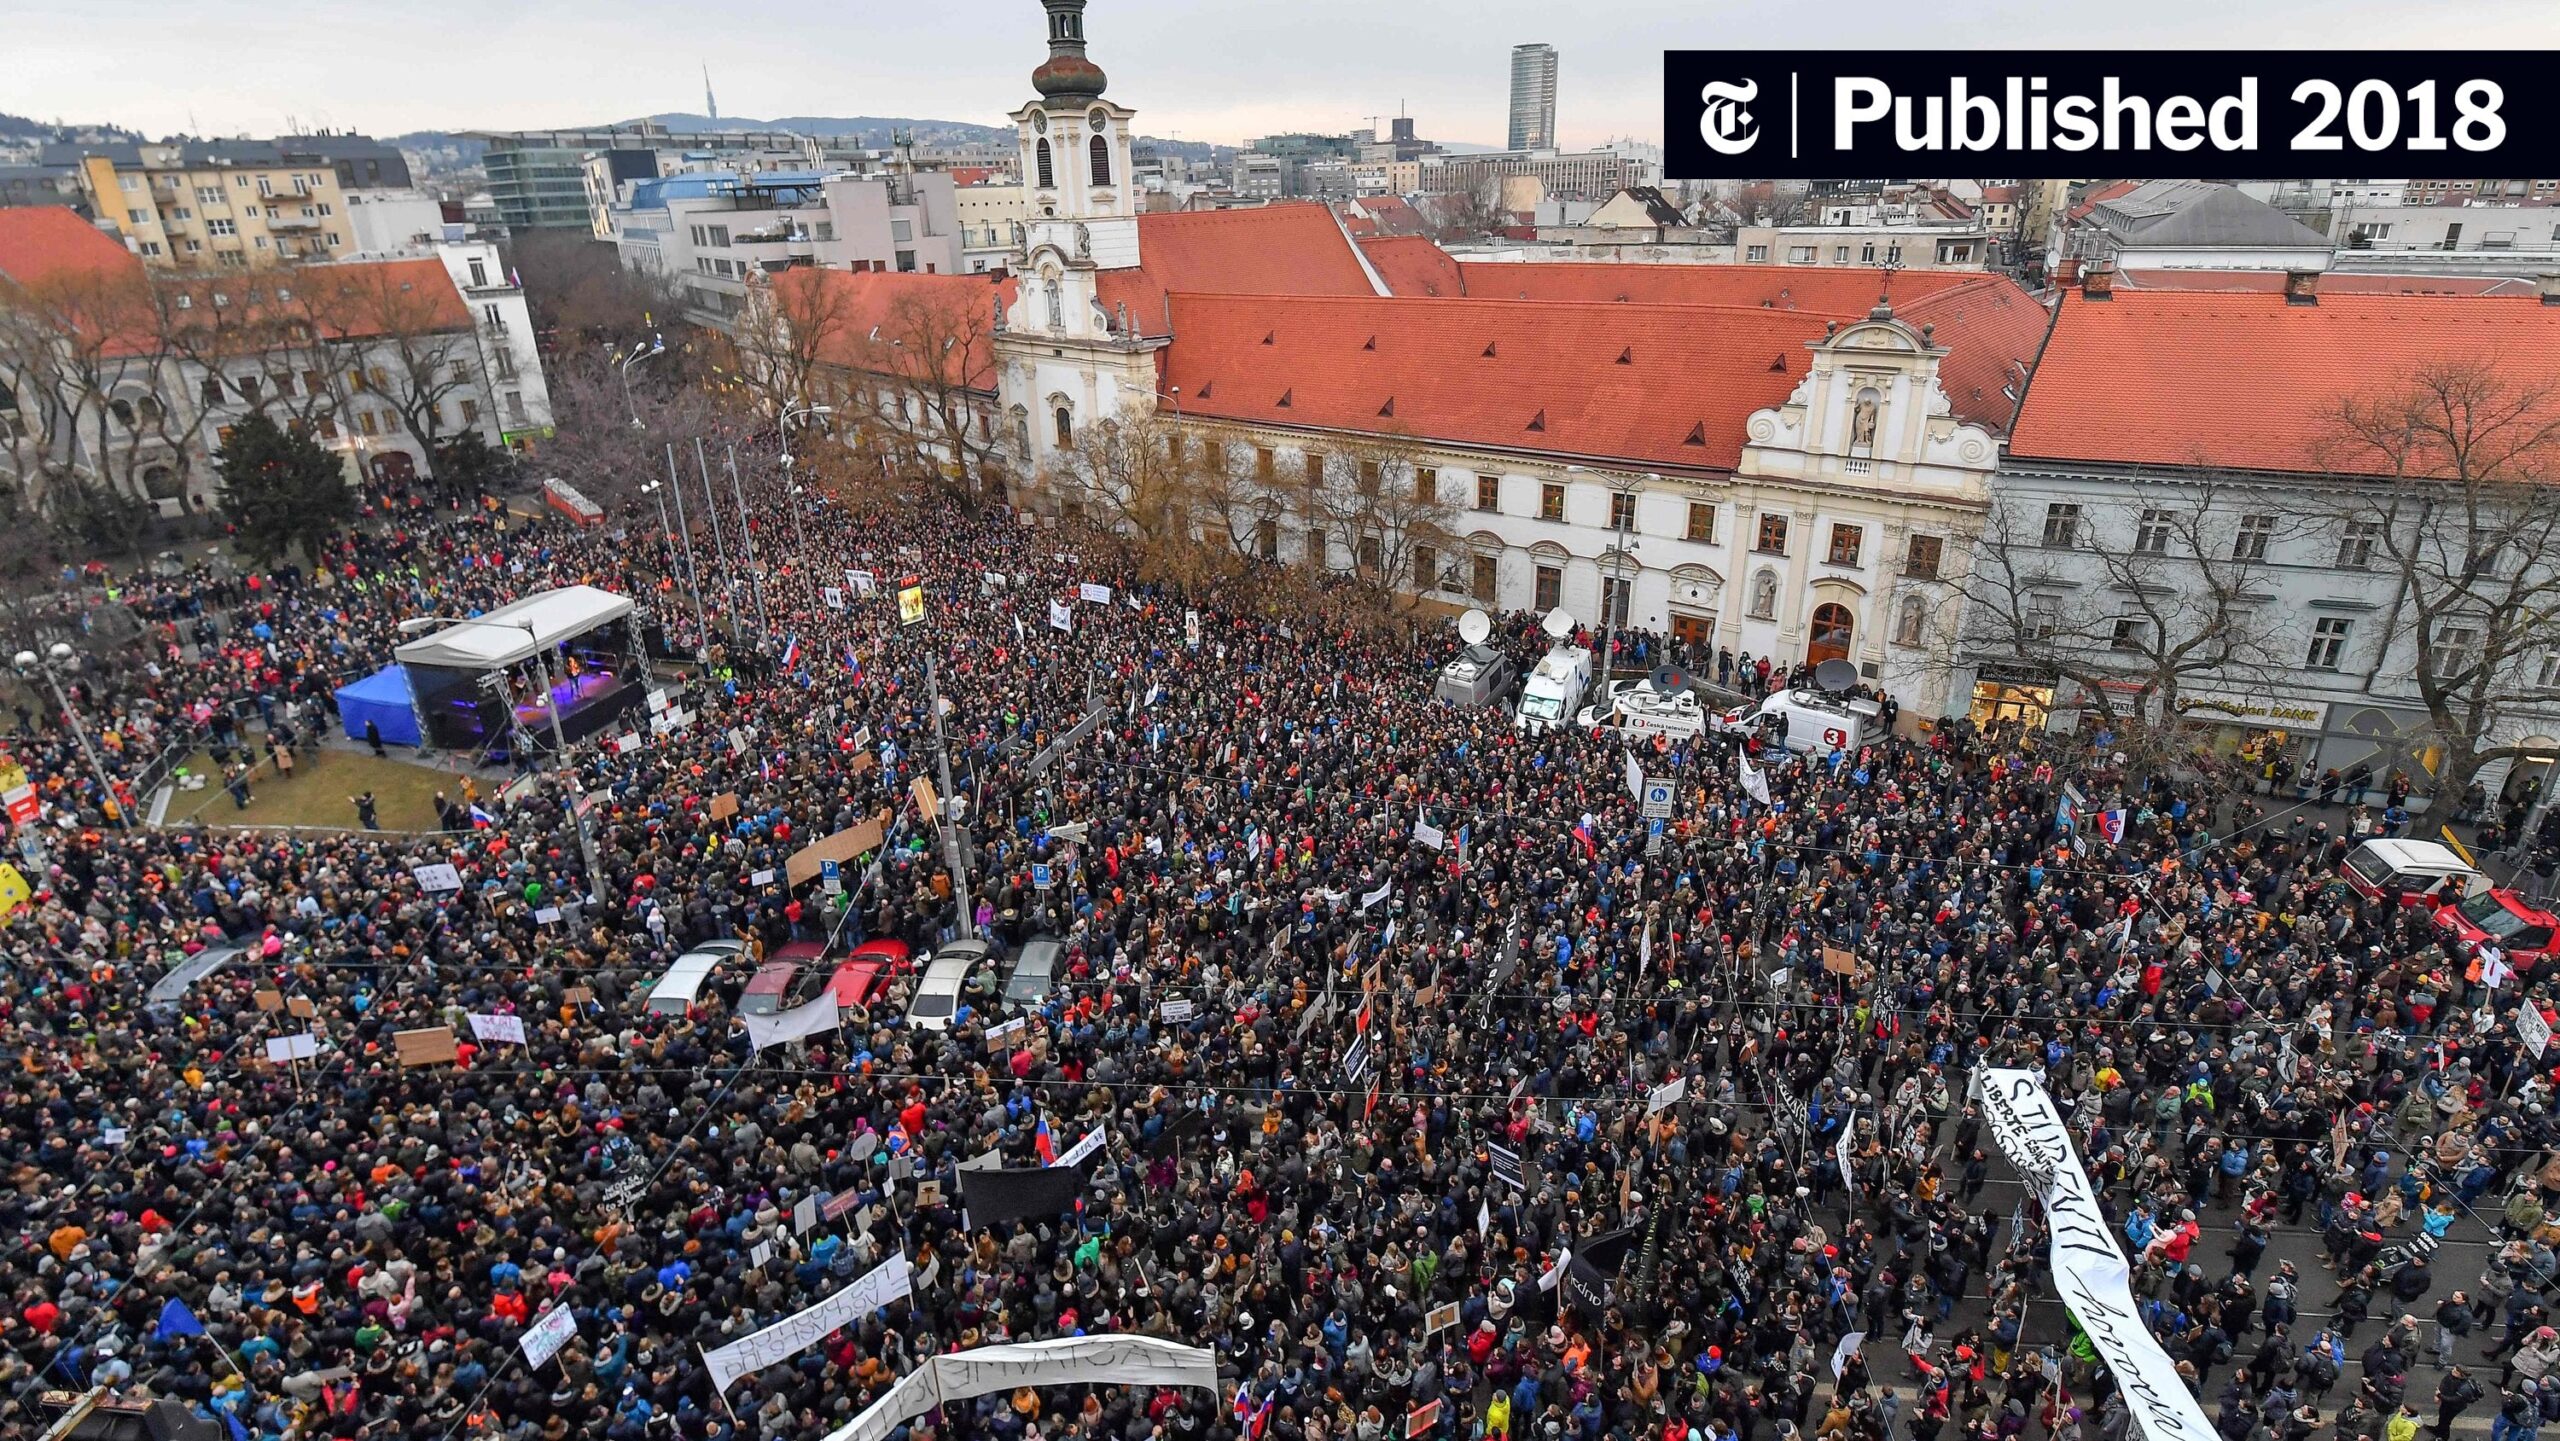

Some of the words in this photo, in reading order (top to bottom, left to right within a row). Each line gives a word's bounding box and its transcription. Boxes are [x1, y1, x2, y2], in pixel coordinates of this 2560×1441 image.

[2270, 705, 2320, 722] BANK
[1646, 720, 1665, 729] Česká
[1665, 724, 1691, 733] televize
[1826, 728, 1839, 743] 3
[2010, 1078, 2119, 1260] ŠTUDENTI
